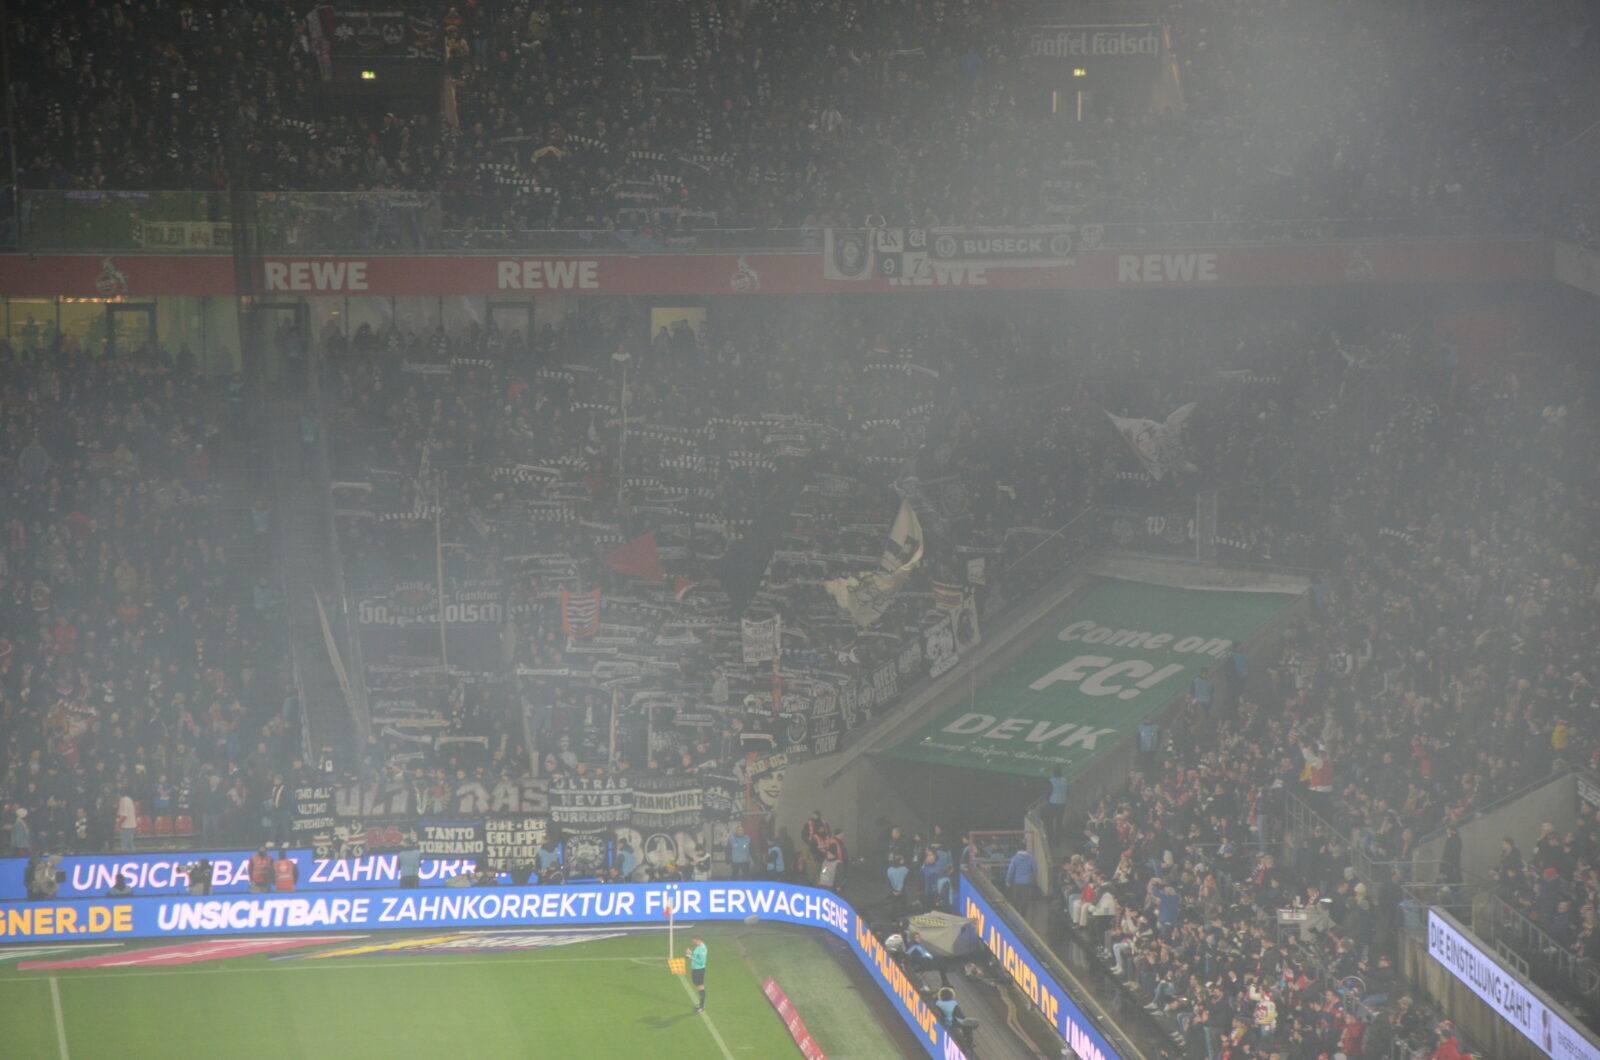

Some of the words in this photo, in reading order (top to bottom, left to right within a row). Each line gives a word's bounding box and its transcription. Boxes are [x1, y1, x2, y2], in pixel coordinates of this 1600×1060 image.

[963, 238, 1043, 254] BUSECK
[263, 260, 369, 291] REWE
[497, 260, 600, 290] REWE
[1117, 253, 1219, 283] REWE
[1057, 619, 1175, 650] Come
[1029, 654, 1185, 701] FC!
[940, 712, 1118, 751] DEVK
[553, 777, 629, 791] ULTRAS
[561, 794, 624, 807] NEVER
[633, 792, 702, 810] FRANKFURT
[551, 810, 632, 823] SURRENDER
[418, 840, 484, 854] TORNANO
[424, 826, 475, 840] TANTO
[156, 897, 370, 932] UNSICHTBARE
[377, 889, 635, 922] ZAHNKORREKTUR
[645, 884, 702, 915] FÜR
[708, 888, 849, 934] ERWACHSENE
[1431, 921, 1444, 956] DIE
[1446, 933, 1502, 1005] EINSTELLUNG
[1503, 981, 1533, 1030] ZÄHLT
